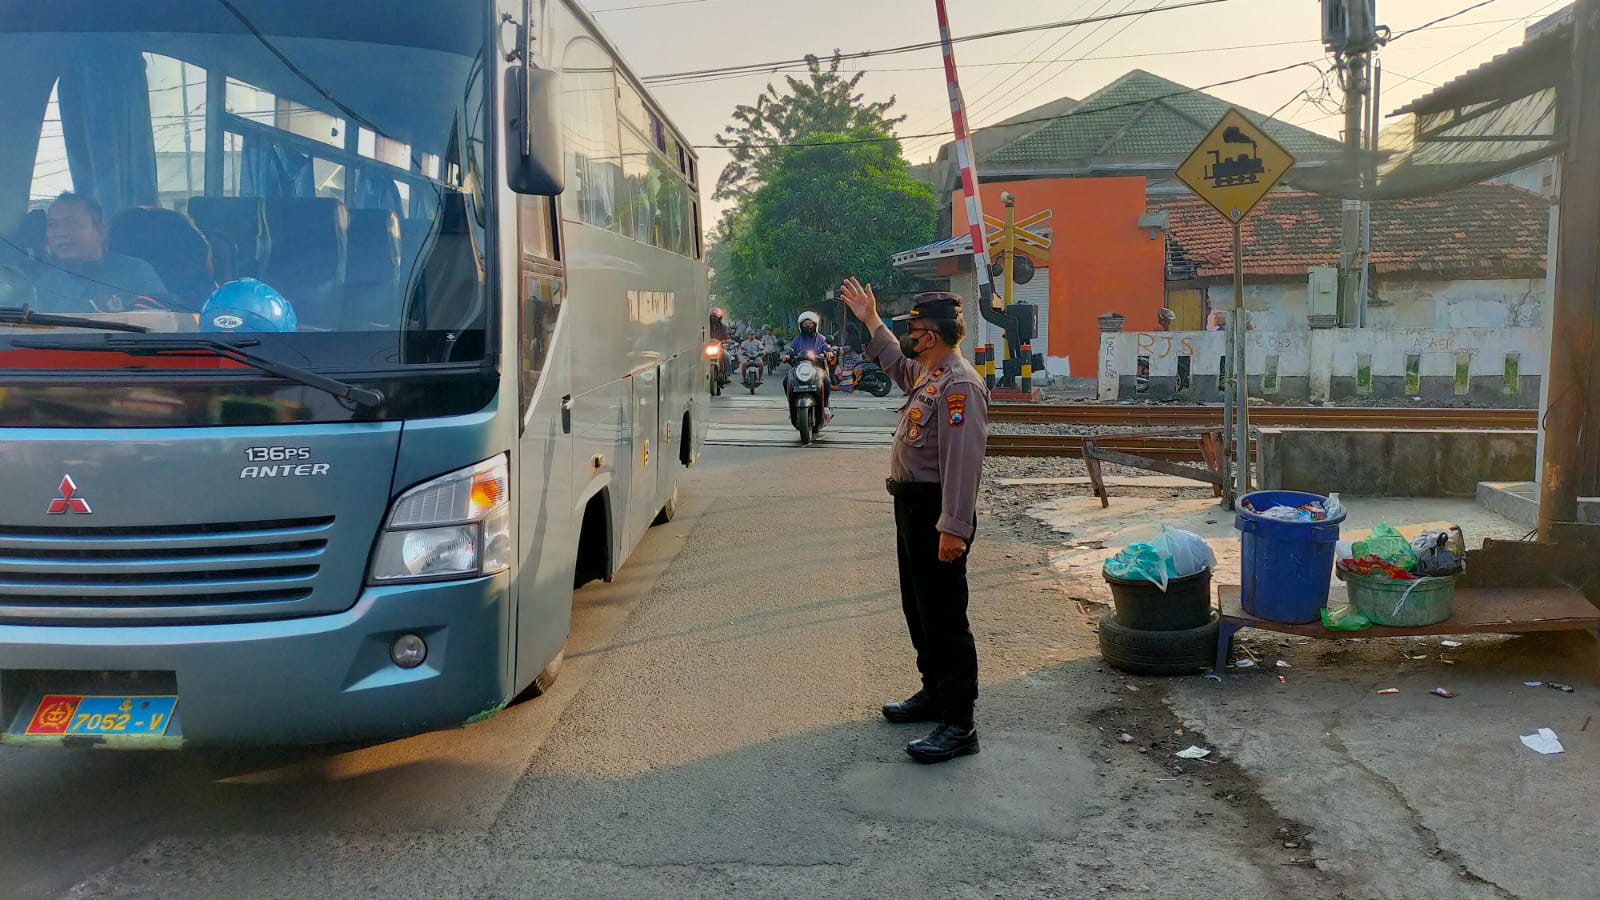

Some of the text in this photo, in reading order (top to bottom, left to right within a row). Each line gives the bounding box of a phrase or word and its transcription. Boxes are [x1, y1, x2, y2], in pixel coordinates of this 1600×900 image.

[1137, 332, 1194, 359] RJS
[245, 446, 310, 461] 136PS
[240, 463, 331, 479] ANTER
[72, 713, 131, 731] 7052
[149, 713, 164, 731] V
